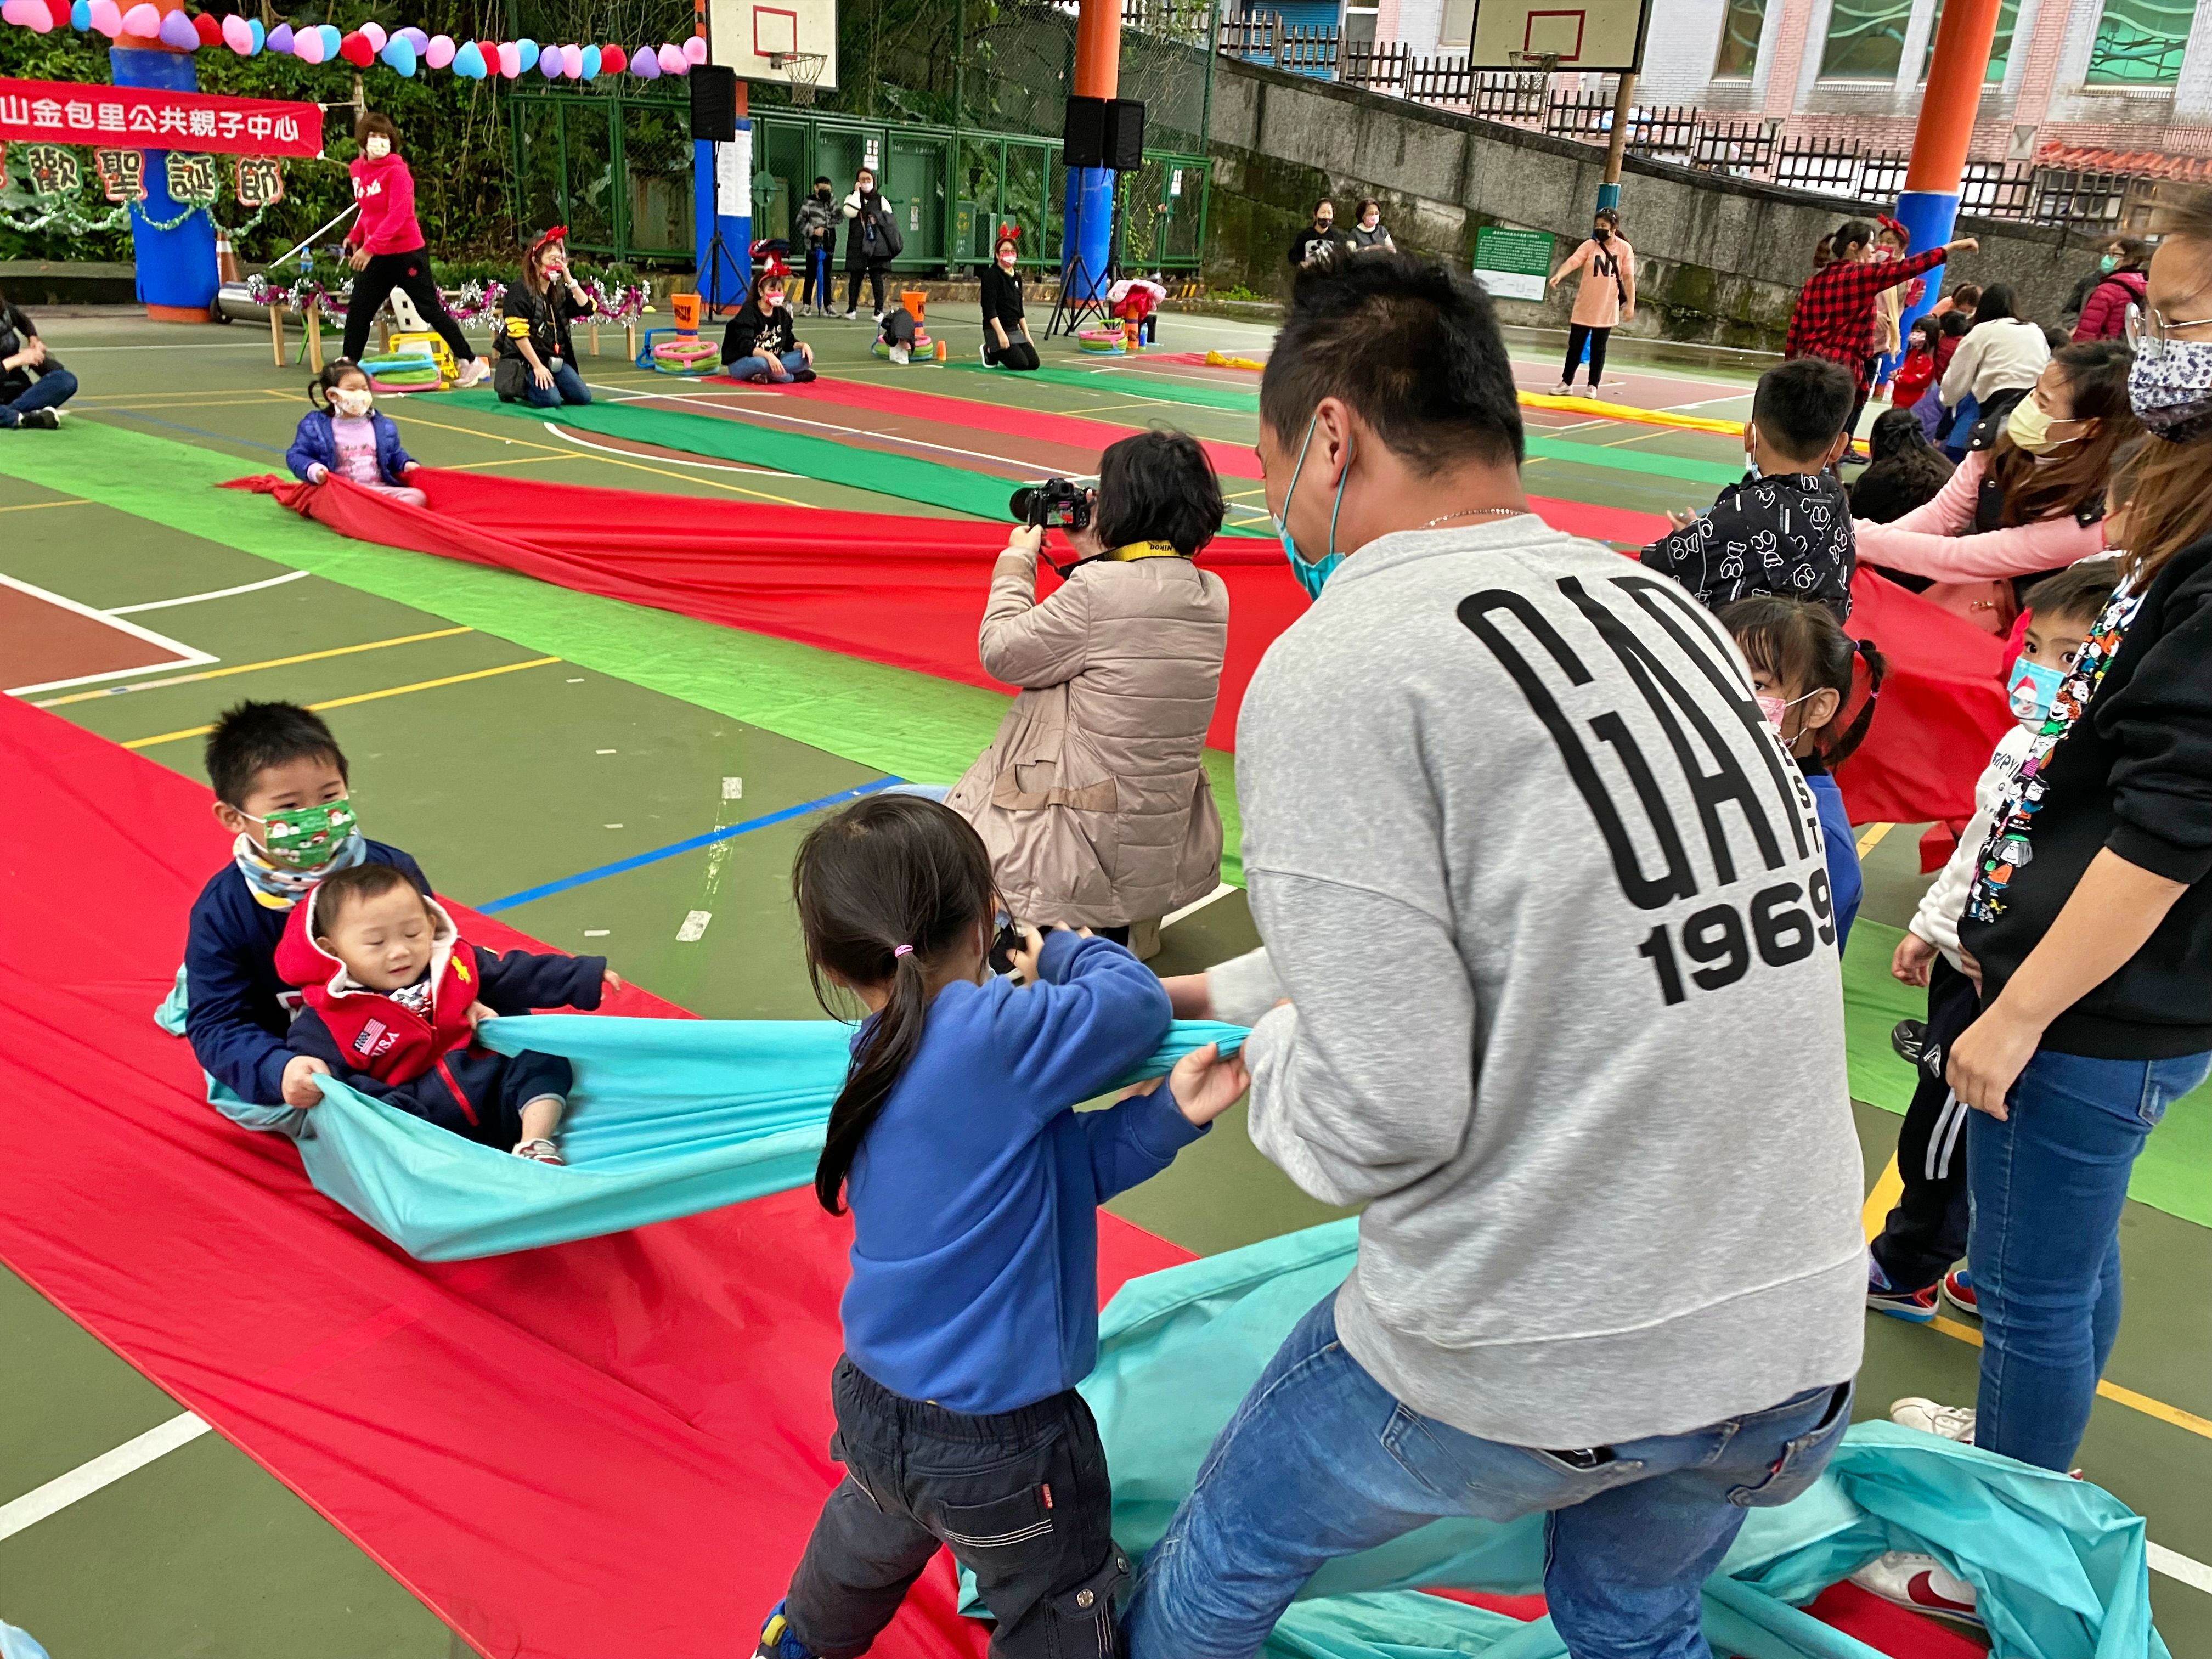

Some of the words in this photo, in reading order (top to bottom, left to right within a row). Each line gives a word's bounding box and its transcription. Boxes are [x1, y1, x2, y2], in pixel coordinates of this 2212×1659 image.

[0, 94, 300, 142] 山金包里公共親子中心
[1457, 575, 1807, 911] GAP
[1637, 867, 1836, 1006] 1969
[370, 1032, 400, 1057] USA
